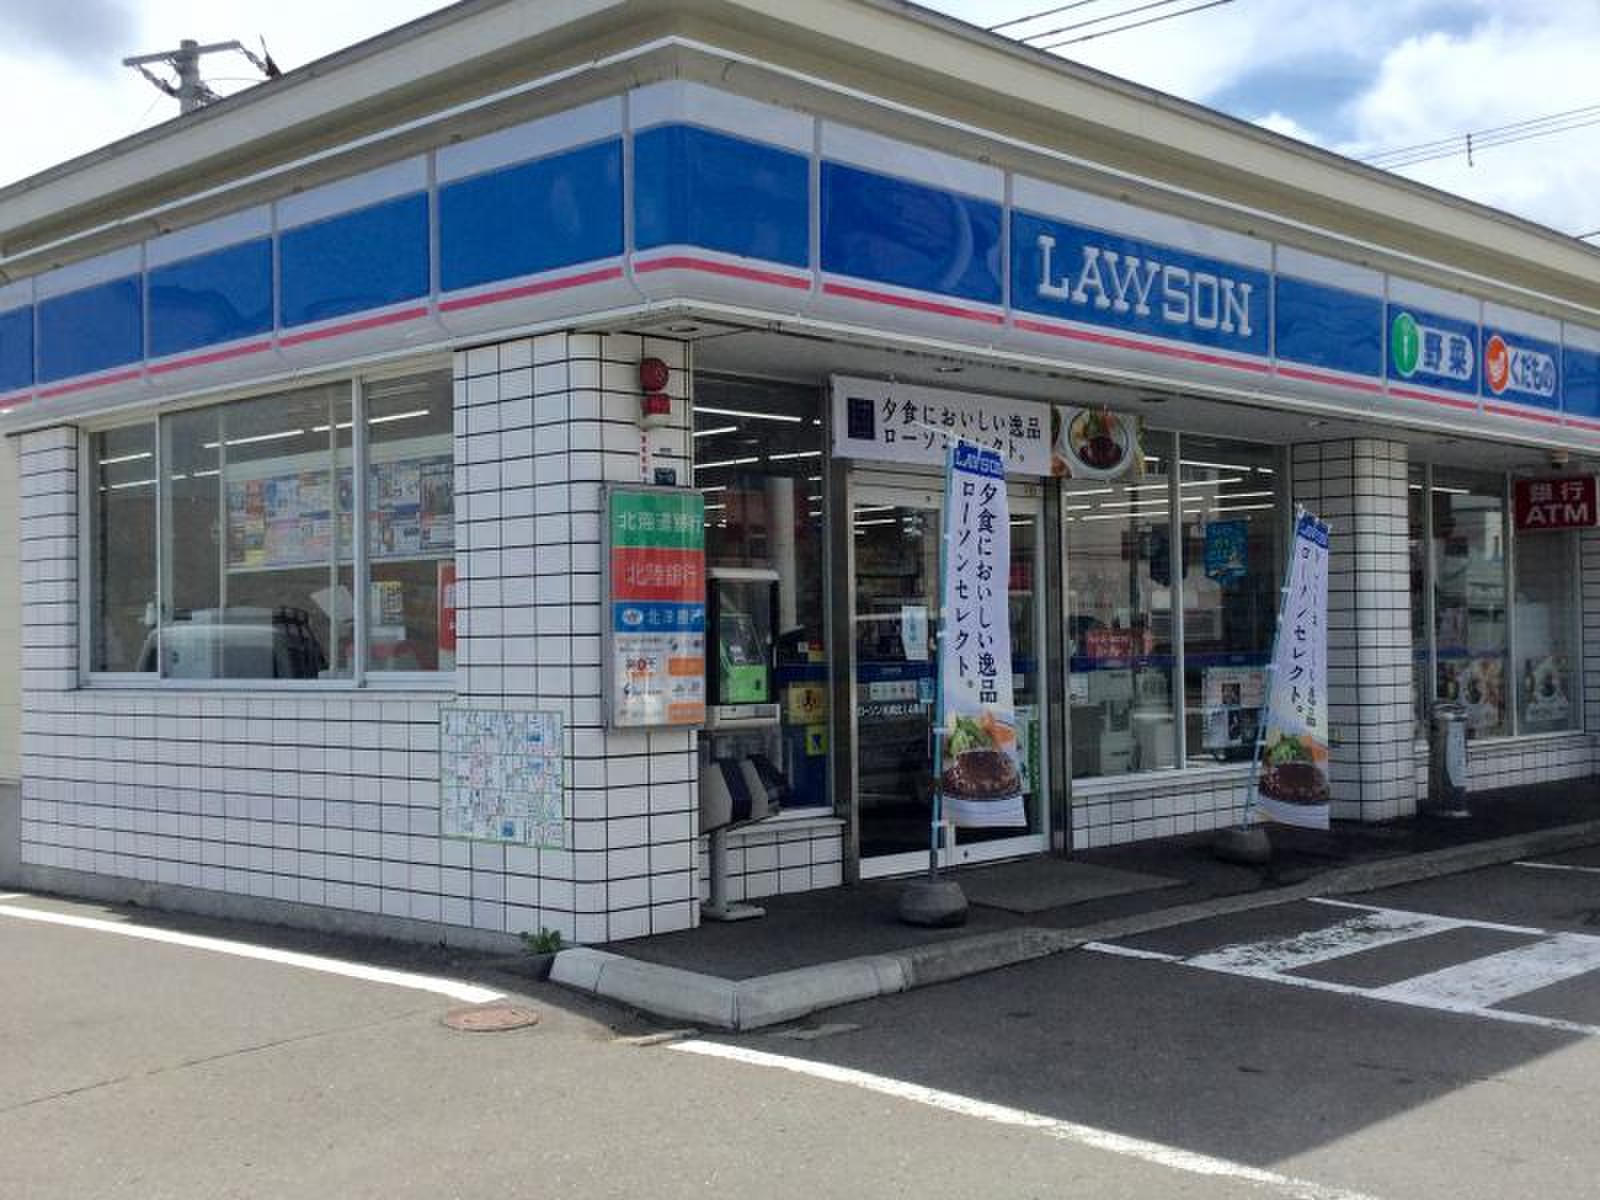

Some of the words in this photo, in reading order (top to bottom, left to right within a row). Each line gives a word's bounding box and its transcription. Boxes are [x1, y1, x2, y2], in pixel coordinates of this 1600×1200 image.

[1037, 235, 1252, 337] LAWSON
[1424, 332, 1468, 375] 野菜
[1510, 351, 1556, 392] くだもの
[882, 397, 1041, 440] 夕食においしい逸品
[1526, 503, 1588, 524] ATM
[955, 481, 976, 688] ローソンセレクト。
[977, 482, 998, 704] 夕食においしい逸品
